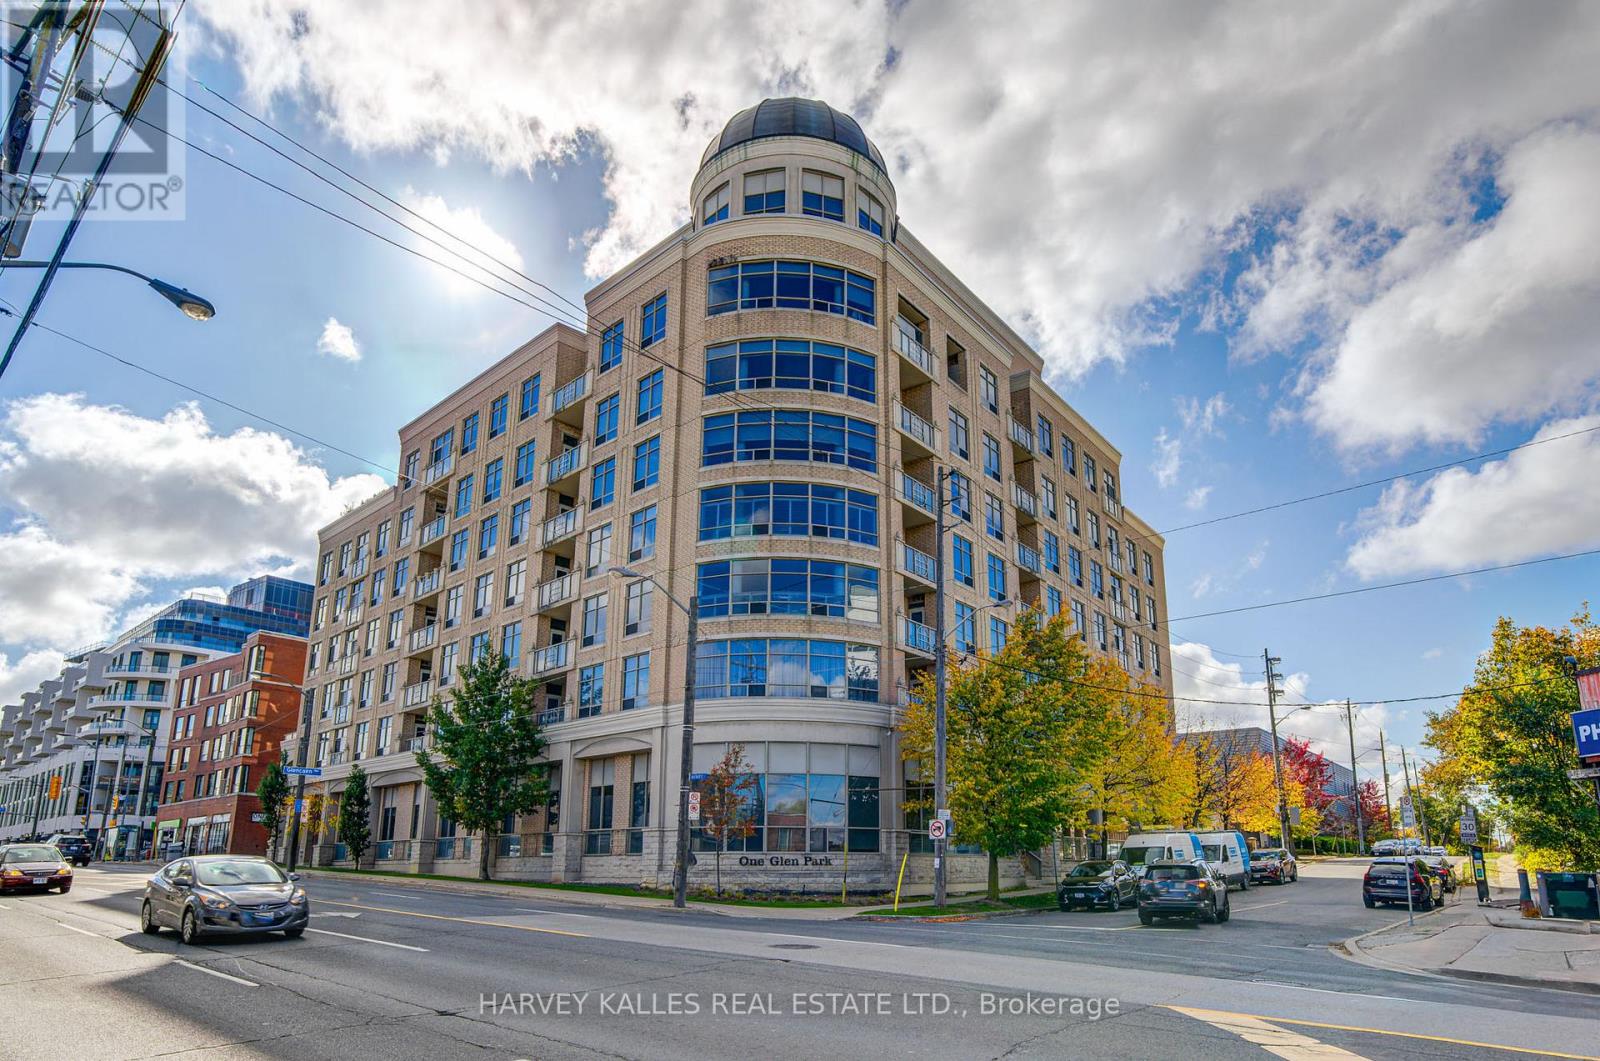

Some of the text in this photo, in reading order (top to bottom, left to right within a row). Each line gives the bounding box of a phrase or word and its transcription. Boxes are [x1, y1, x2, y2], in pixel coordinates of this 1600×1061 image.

[1462, 823, 1475, 832] 30
[739, 856, 833, 866] One Glen Park
